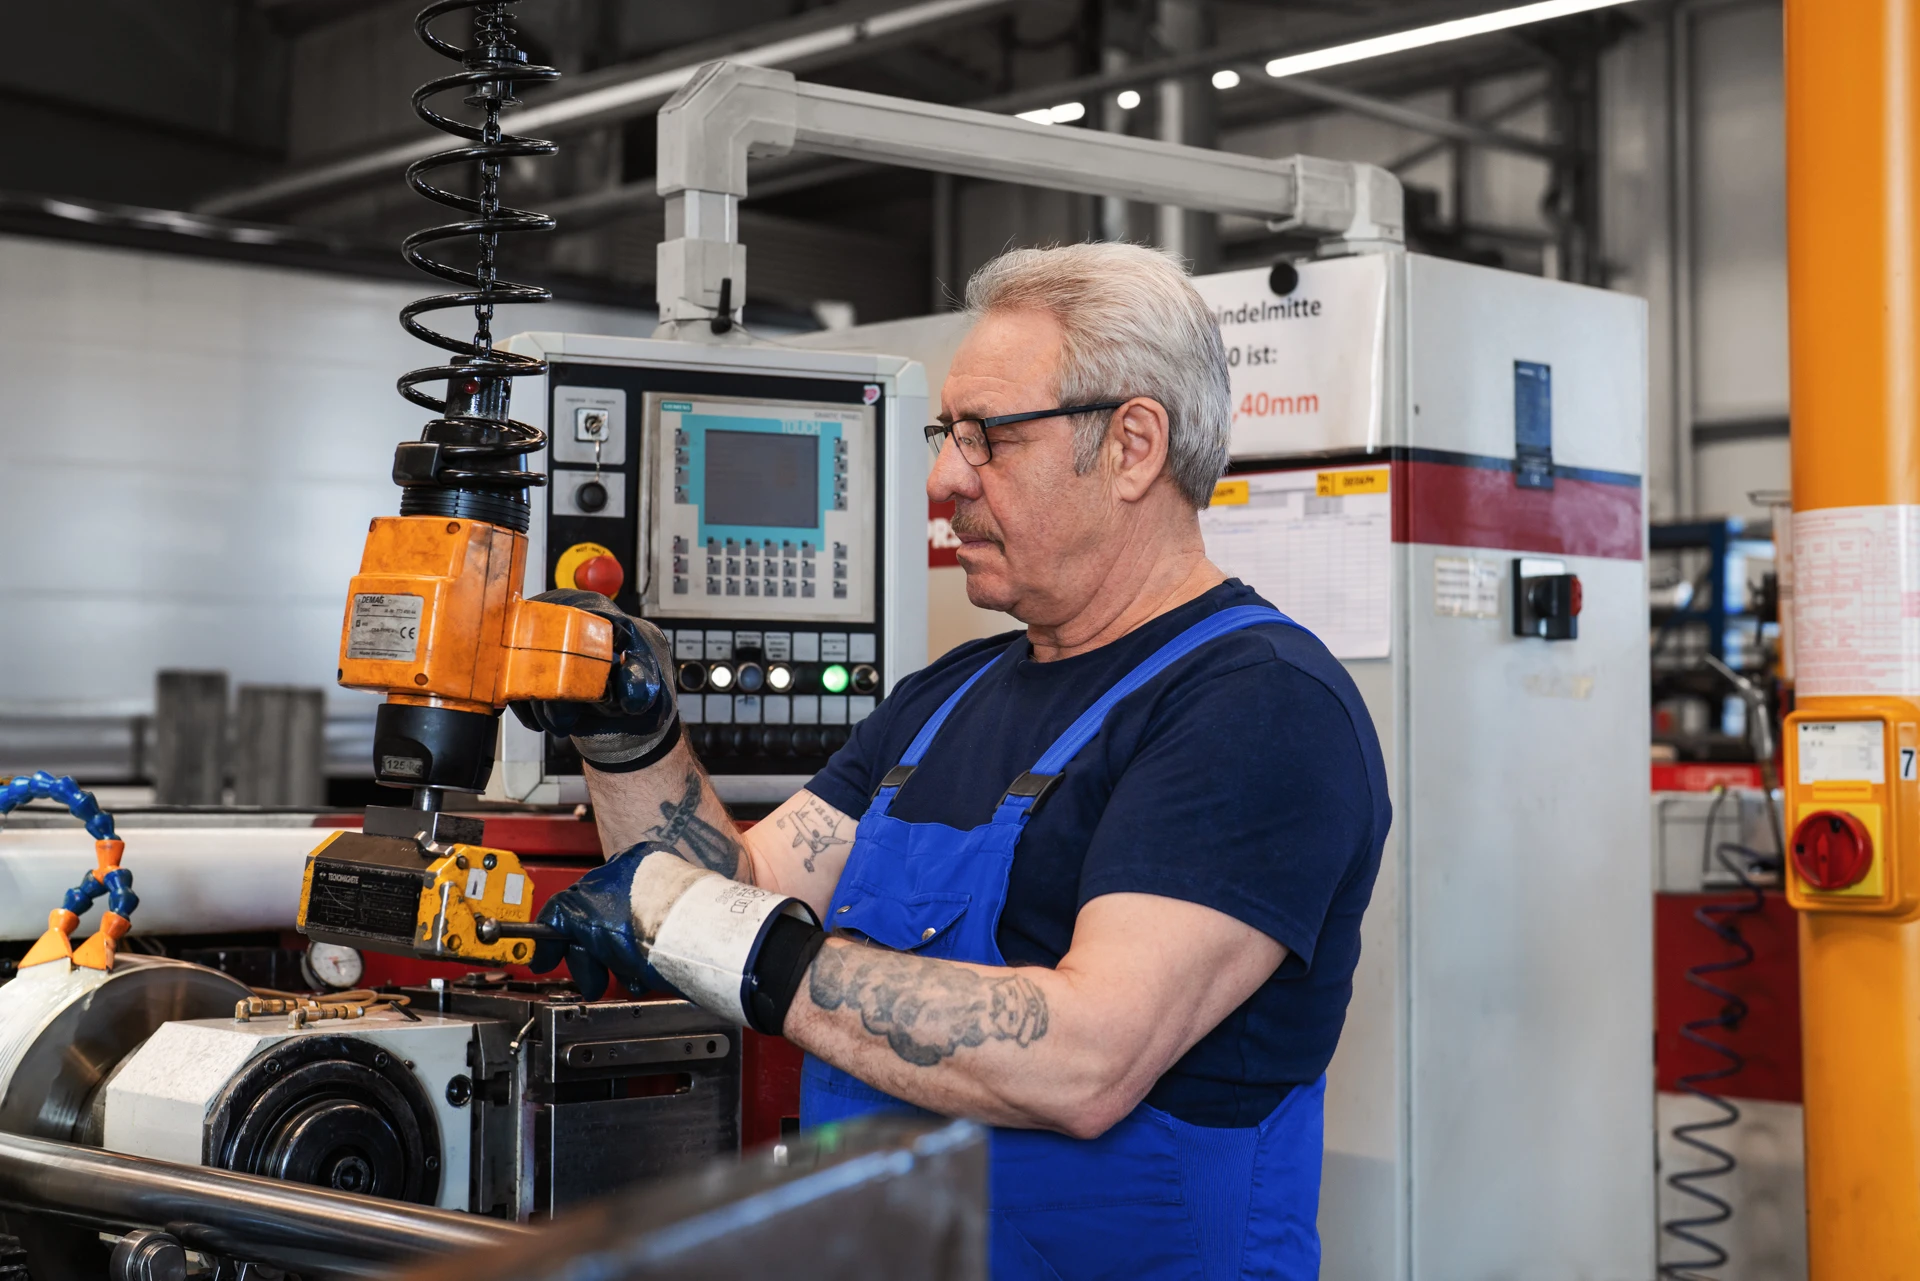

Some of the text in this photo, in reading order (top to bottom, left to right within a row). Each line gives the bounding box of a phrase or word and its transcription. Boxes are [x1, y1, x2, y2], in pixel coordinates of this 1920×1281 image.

[1217, 299, 1322, 326] indelmitte
[1228, 345, 1278, 367] 0 ist:
[1232, 392, 1320, 422] ,40mm
[781, 419, 821, 434] TOUCH
[362, 596, 385, 604] DEMAG
[400, 626, 416, 640] CE
[387, 759, 406, 771] 125
[1901, 749, 1915, 778] 7
